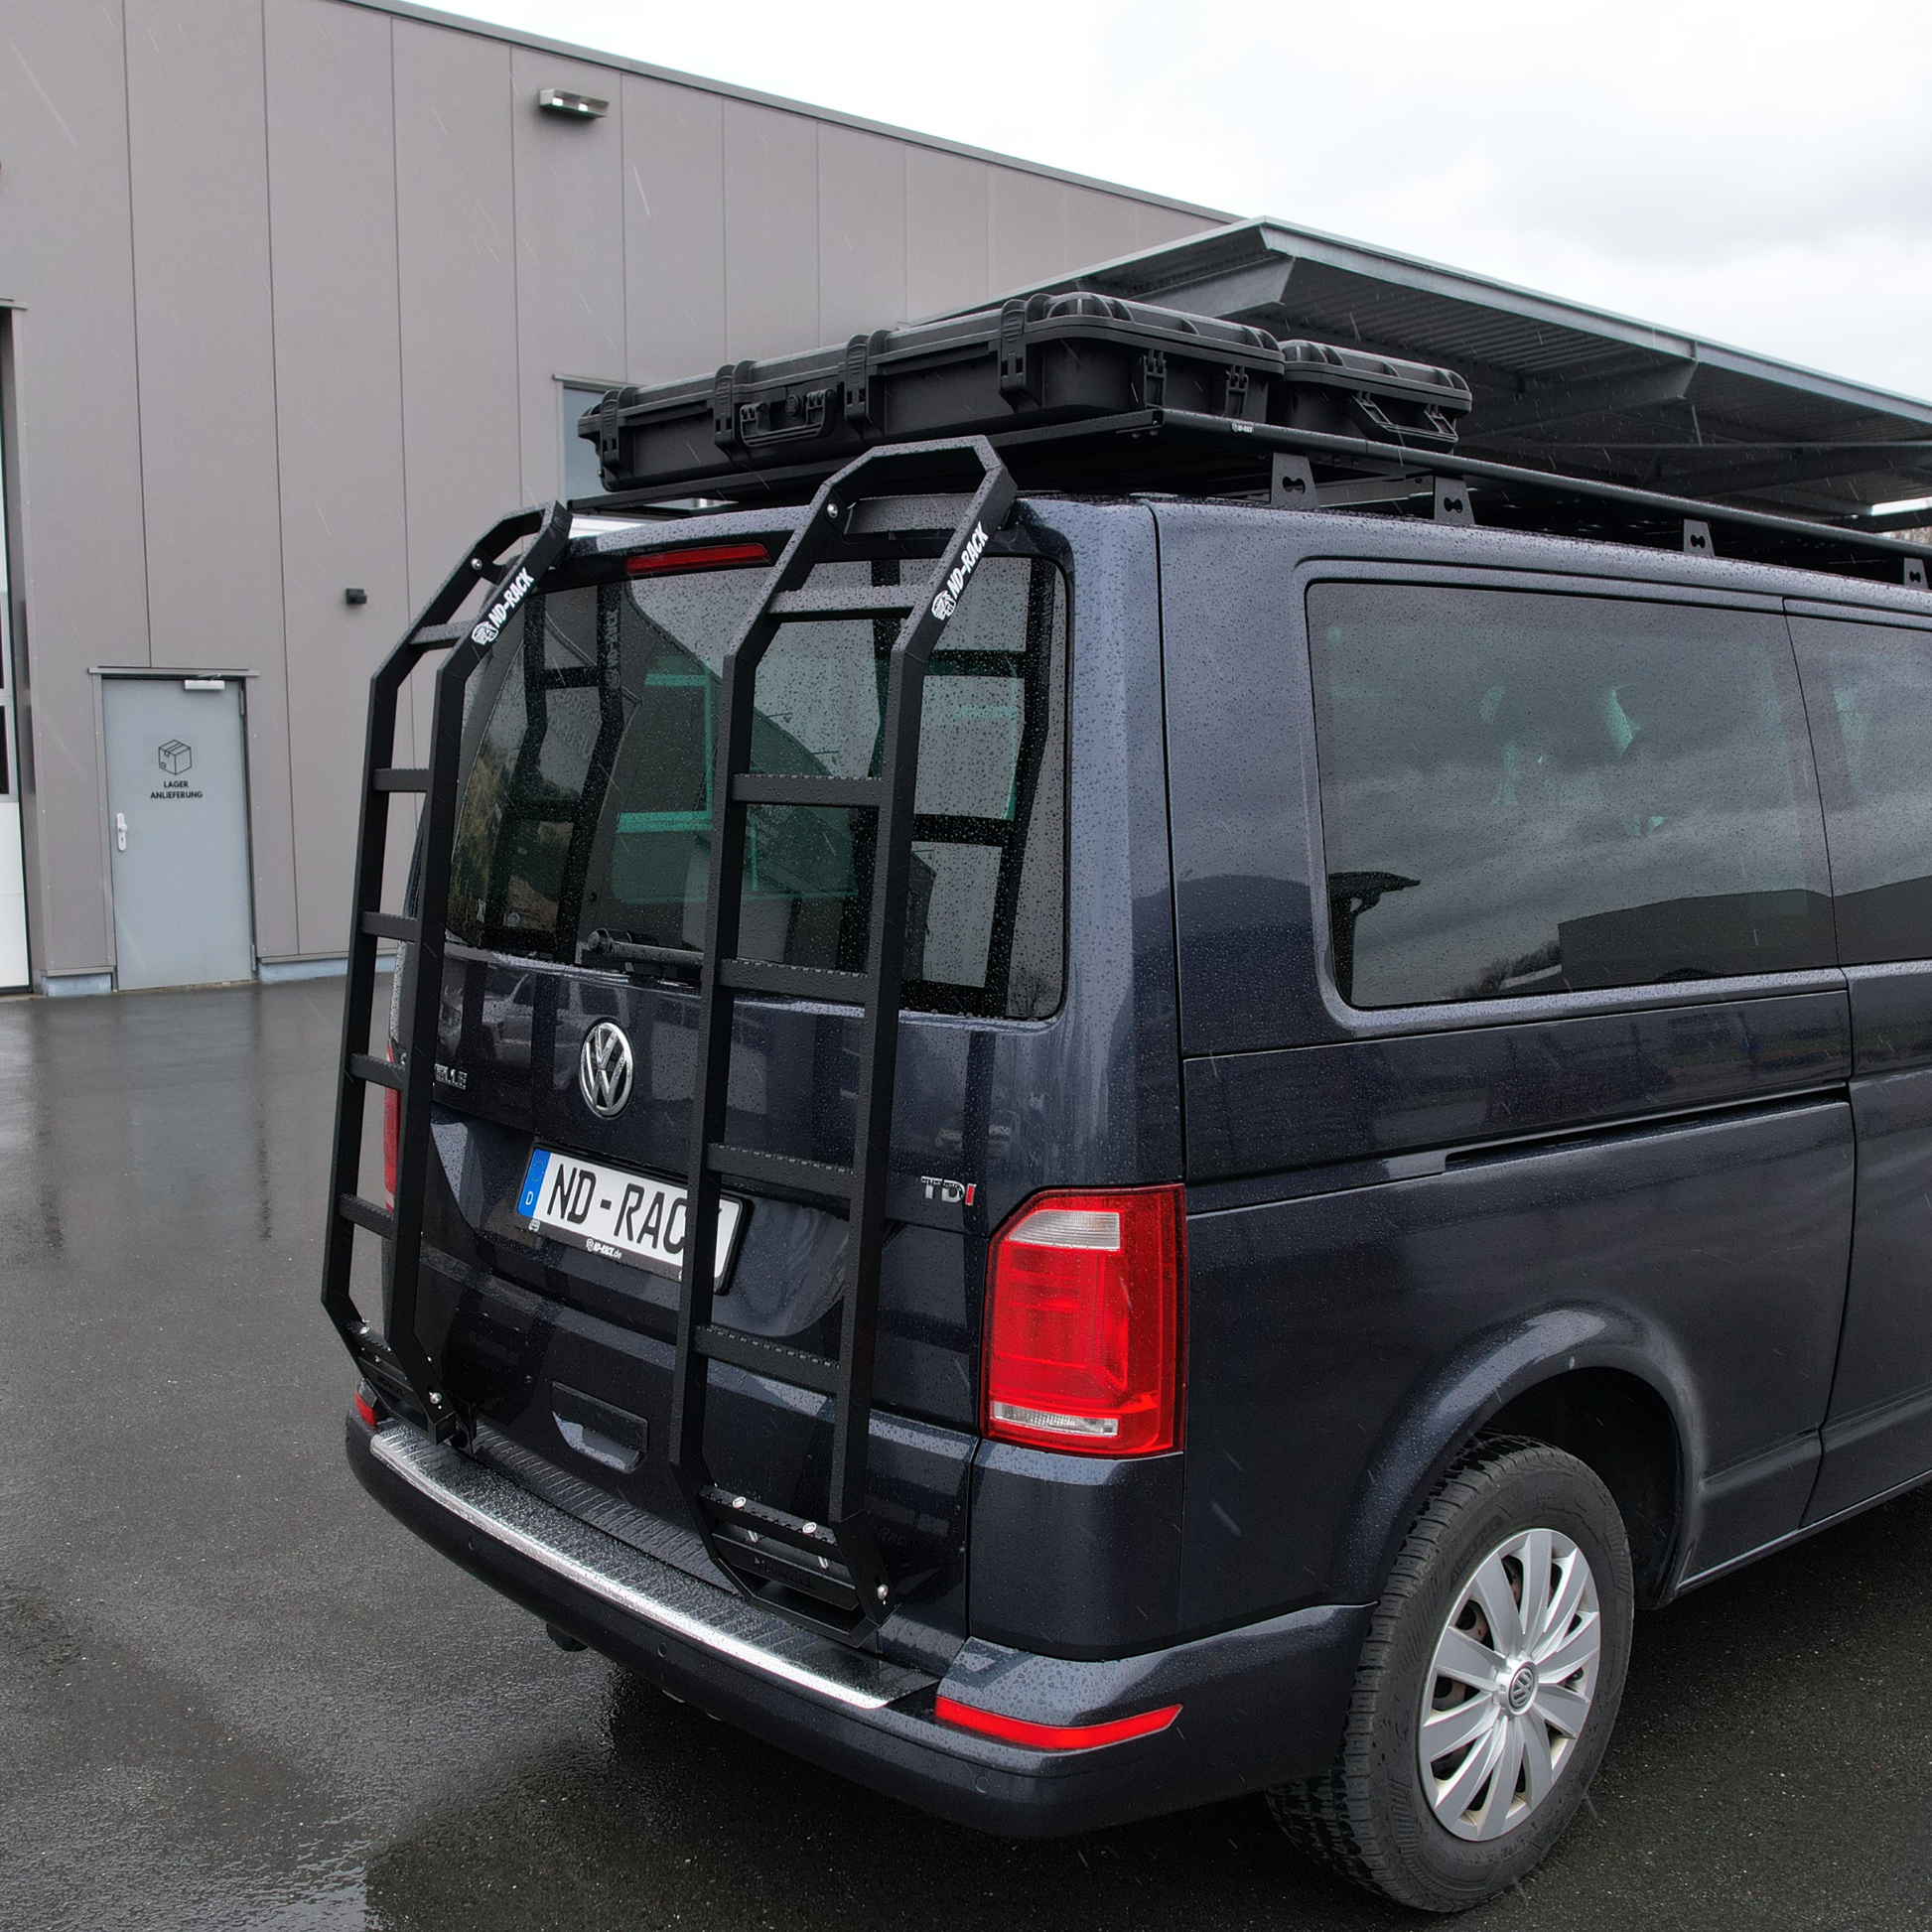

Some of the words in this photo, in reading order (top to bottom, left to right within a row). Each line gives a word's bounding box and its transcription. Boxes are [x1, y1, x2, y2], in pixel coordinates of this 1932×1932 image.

[947, 521, 989, 600] ND-RACK
[488, 567, 534, 628] ND-RACK
[150, 790, 204, 799] ANLIEFERUNG
[434, 1062, 468, 1091] ELLE
[524, 1190, 534, 1206] D
[920, 1175, 977, 1206] TDI
[547, 1163, 688, 1255] ND-RAC
